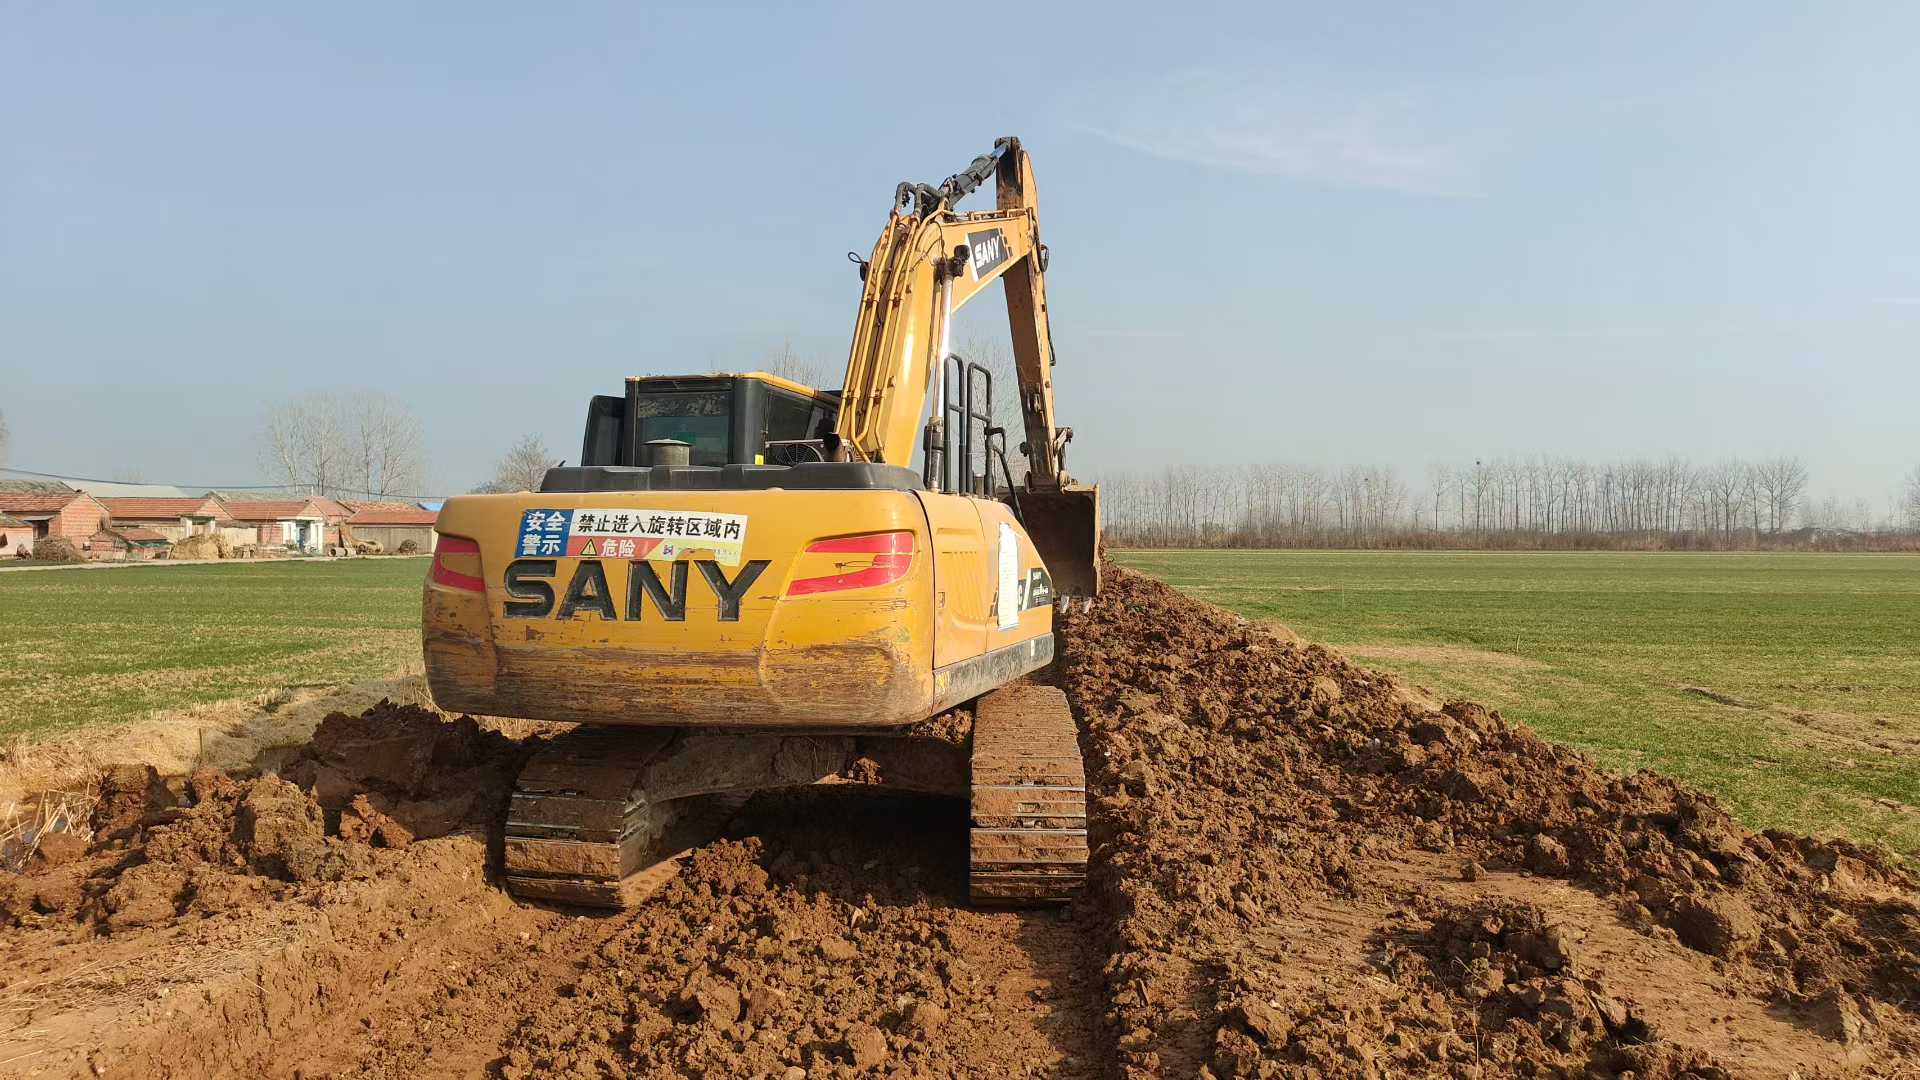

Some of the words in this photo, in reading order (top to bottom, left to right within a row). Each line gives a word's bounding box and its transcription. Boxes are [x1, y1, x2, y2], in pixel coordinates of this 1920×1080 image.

[974, 235, 1000, 269] SANY
[525, 511, 566, 532] 安全
[577, 513, 741, 540] 禁止进入旋转区域内
[521, 533, 562, 555] 警示
[601, 538, 637, 558] 危险
[503, 559, 773, 622] SANY
